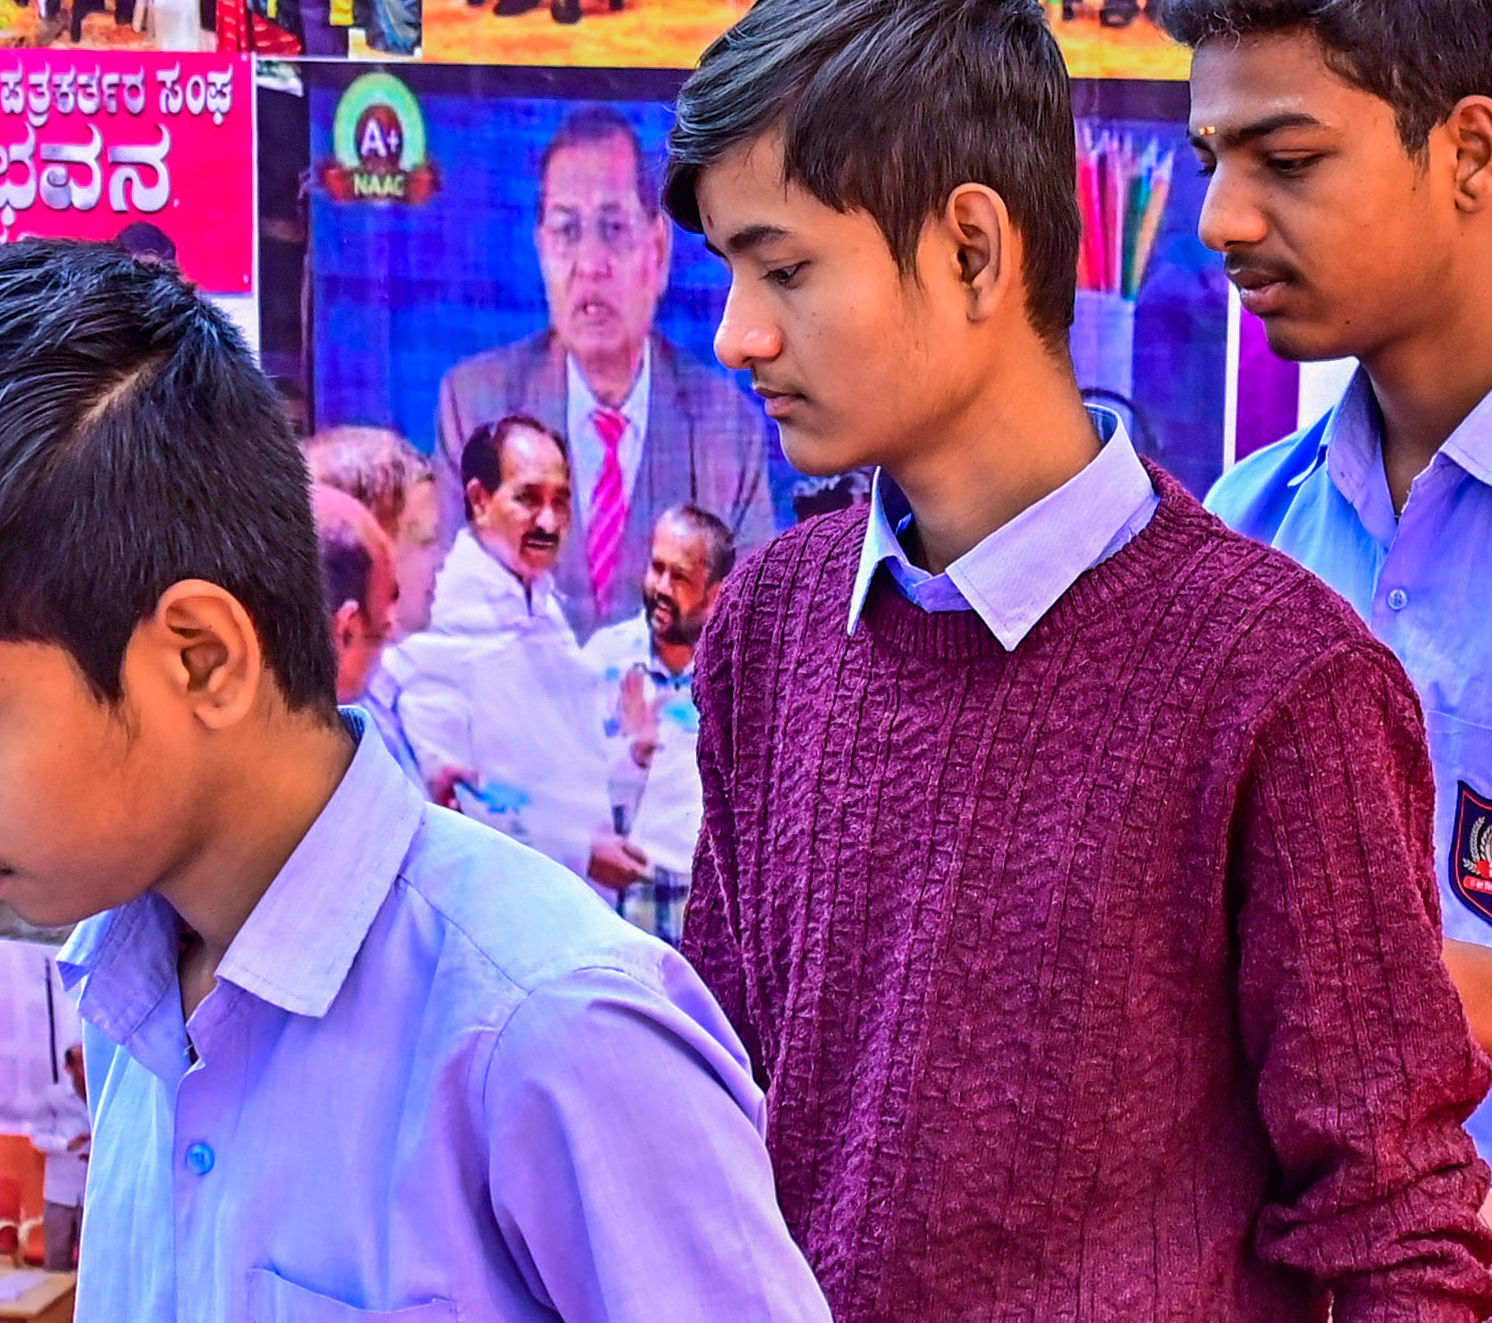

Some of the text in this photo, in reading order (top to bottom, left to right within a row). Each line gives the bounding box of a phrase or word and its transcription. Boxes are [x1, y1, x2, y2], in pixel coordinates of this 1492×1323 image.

[0, 60, 146, 127] ಪತ್ರಕರ್ತರ
[159, 63, 233, 125] ಸಂಘ
[359, 119, 400, 153] A+
[353, 173, 404, 198] NAAC
